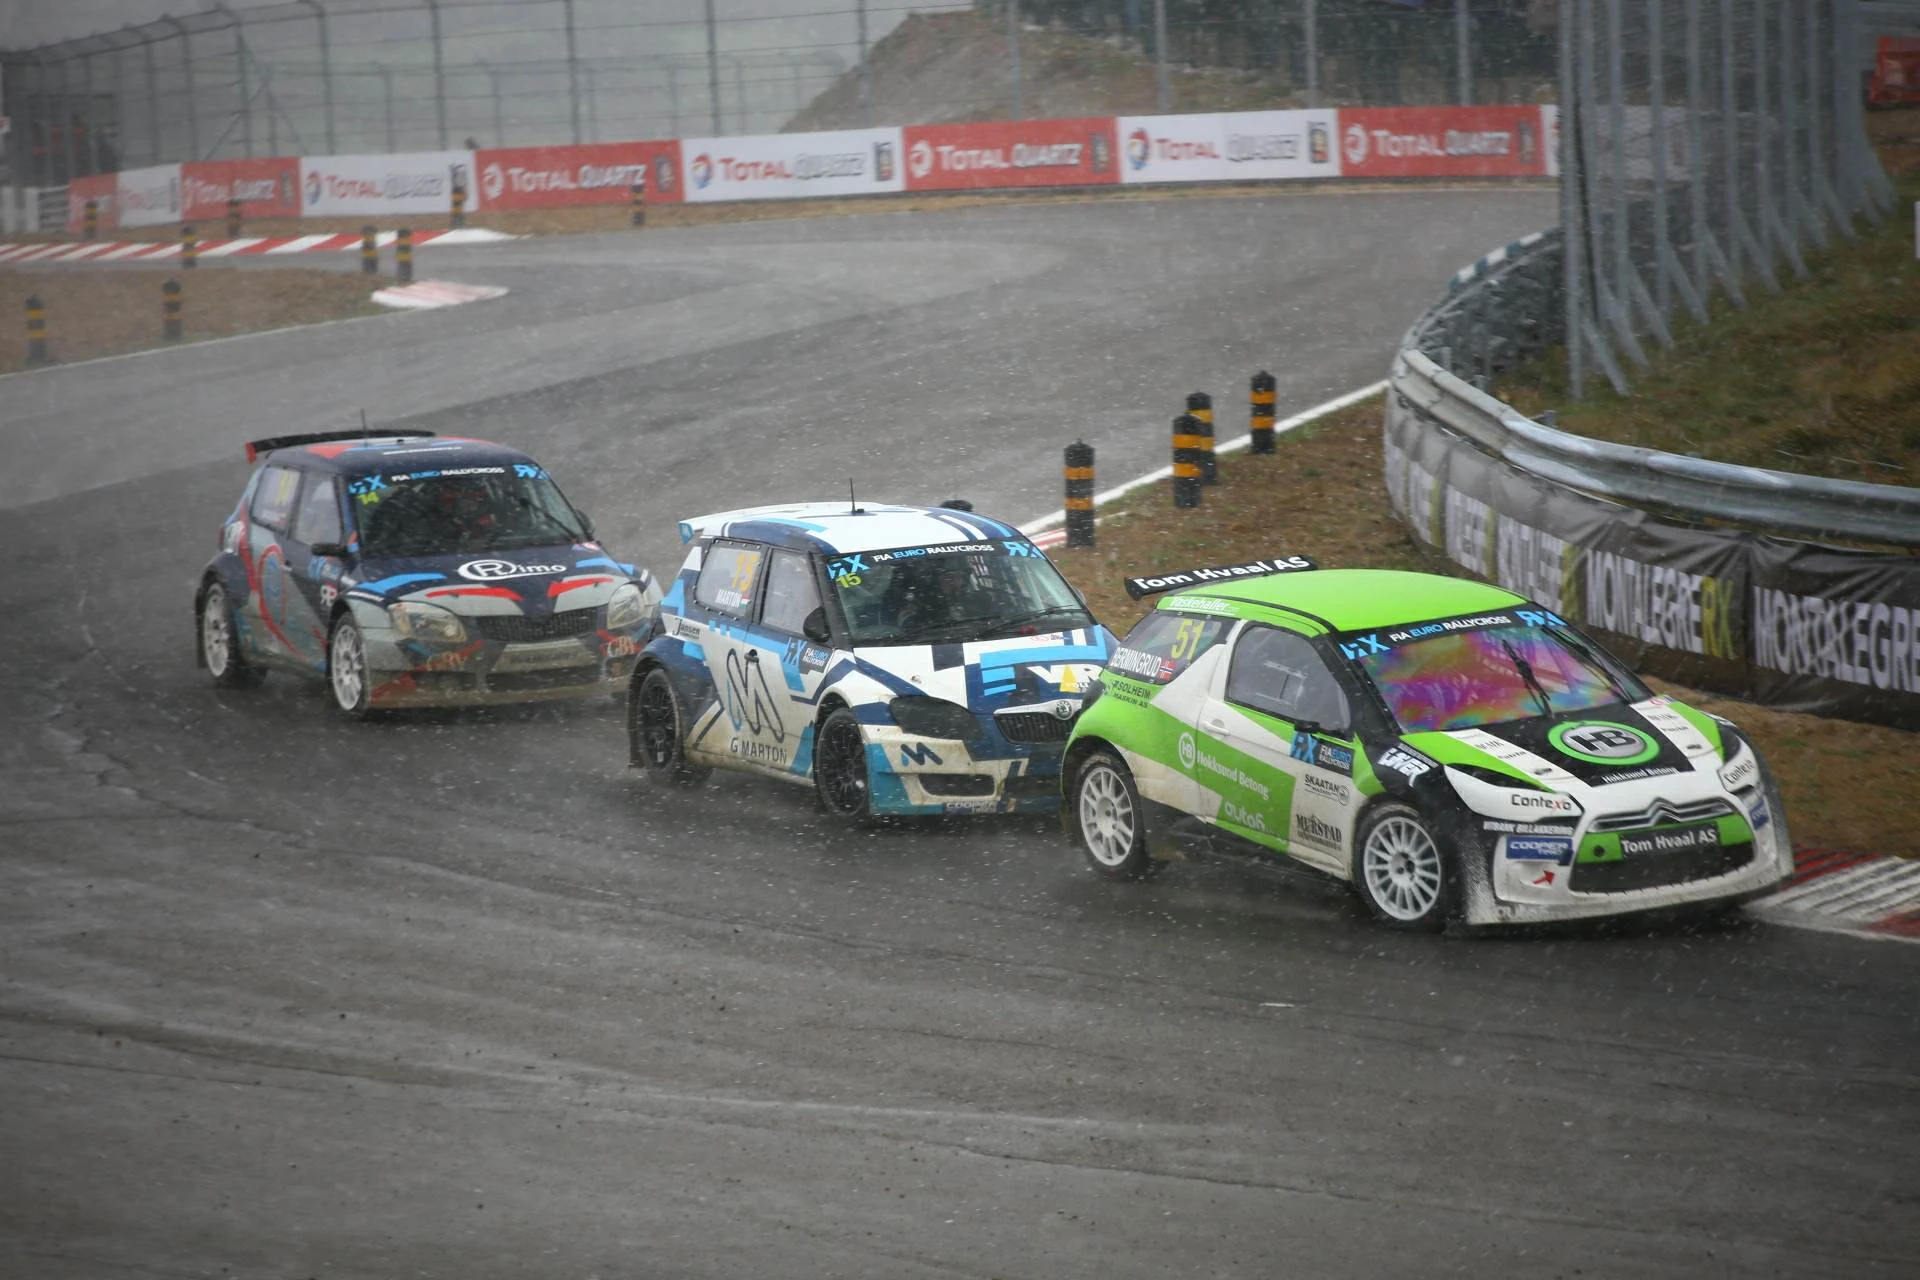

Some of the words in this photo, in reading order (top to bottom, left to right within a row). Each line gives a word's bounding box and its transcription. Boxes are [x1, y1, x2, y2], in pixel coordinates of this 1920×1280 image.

[1156, 137, 1220, 160] TOTAL
[1372, 130, 1445, 157] TOTAL
[1445, 129, 1510, 156] QUARTZ
[719, 156, 793, 181] TOTAL
[936, 144, 1010, 170] TOTAL
[1011, 142, 1083, 167] QUARTZ
[324, 173, 384, 199] TOTAL
[508, 166, 578, 192] TOTAL
[578, 163, 647, 188] QUARTZ
[873, 553, 894, 563] FIA
[893, 549, 926, 560] EURO
[926, 544, 995, 554] RALLYCROSS
[836, 573, 863, 589] 15
[1135, 574, 1191, 590] Tom
[1193, 560, 1273, 580] Hvaal
[1273, 556, 1311, 570] AS
[1171, 619, 1206, 660] 51
[1389, 631, 1412, 642] FIA
[1410, 624, 1444, 638] EURO
[1443, 615, 1512, 631] RALLYCROSS
[731, 738, 739, 753] G
[741, 740, 788, 764] MARTON
[1570, 729, 1640, 752] HB
[1511, 794, 1572, 811] Contexo
[1509, 841, 1569, 850] COOPER
[1621, 839, 1652, 854] Tom
[1655, 831, 1696, 849] Hvaal
[1698, 829, 1719, 844] AS
